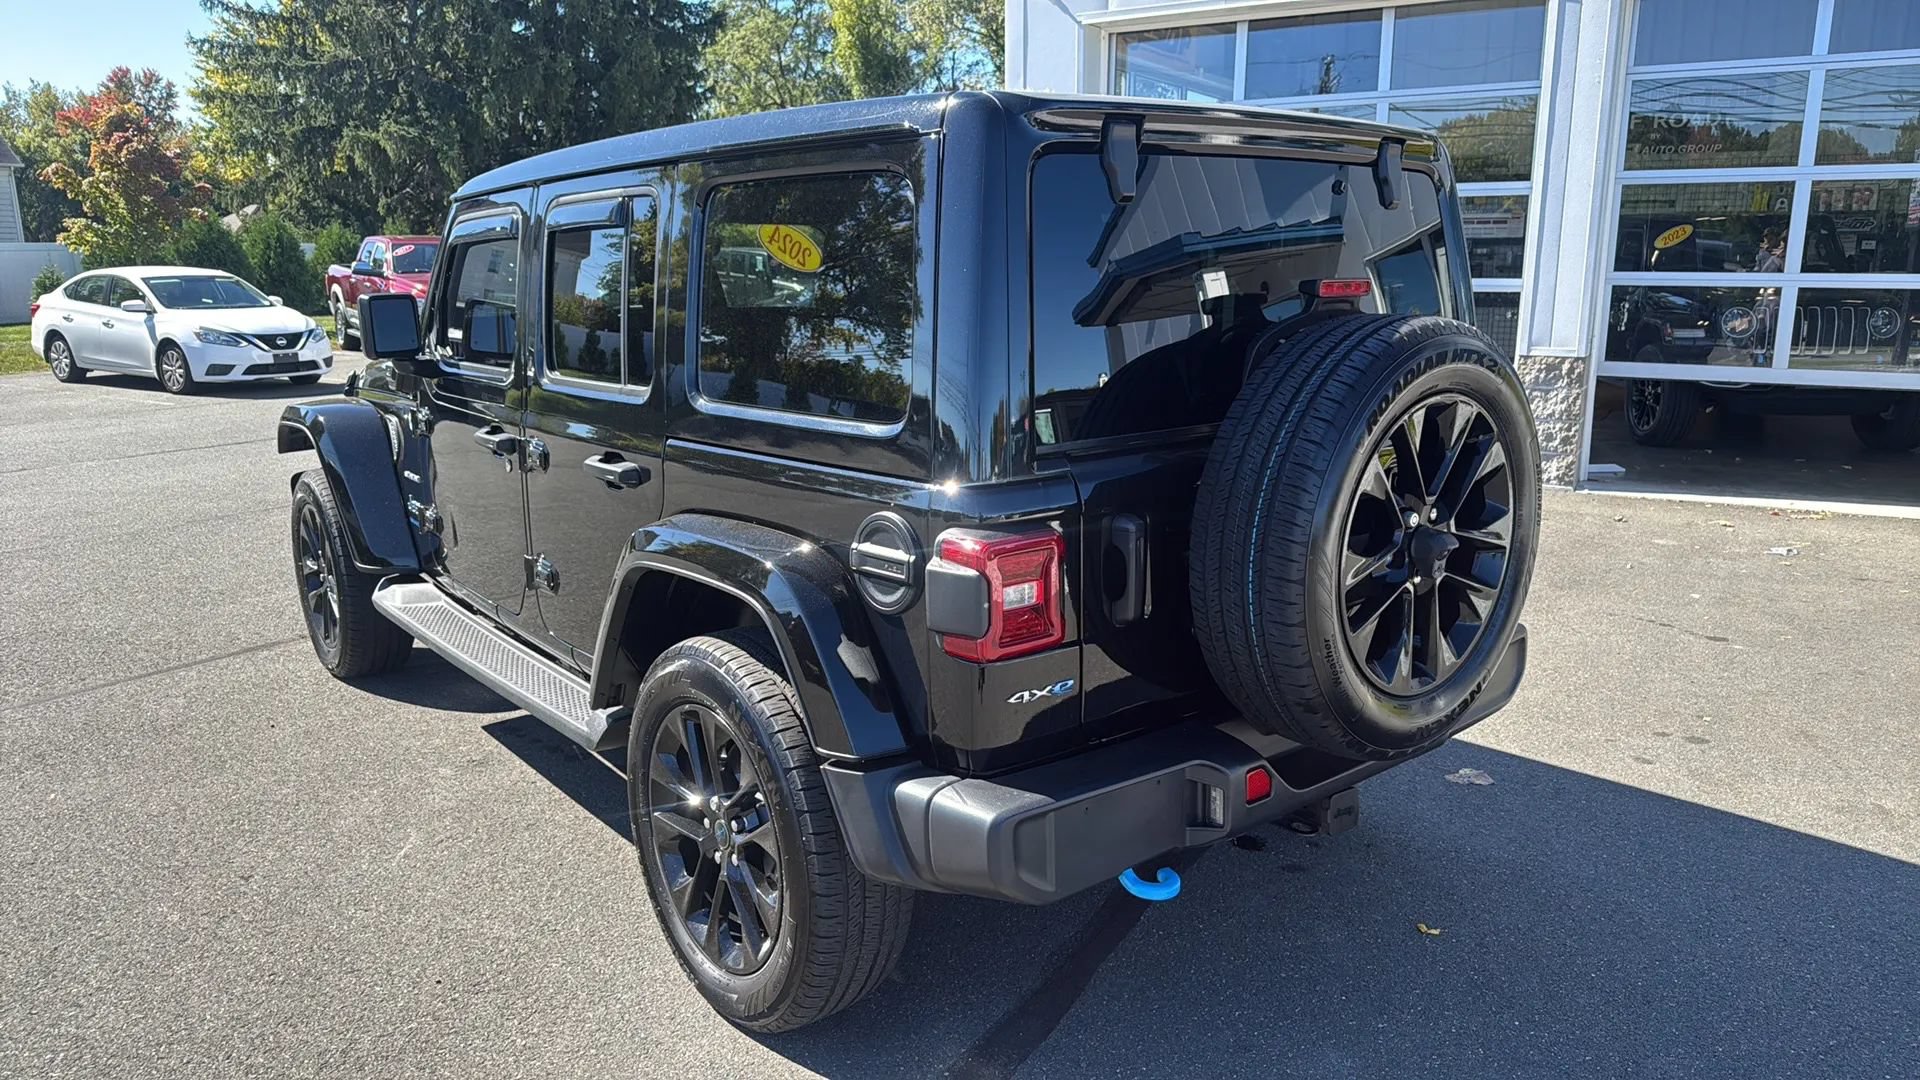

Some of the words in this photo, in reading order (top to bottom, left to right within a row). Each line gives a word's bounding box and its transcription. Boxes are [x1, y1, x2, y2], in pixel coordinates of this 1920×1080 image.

[1641, 145, 1675, 156] AUTO
[1677, 143, 1723, 154] GROUP
[1660, 227, 1687, 246] 2023
[1366, 350, 1449, 437] ROADIAN
[1323, 637, 1342, 688] Weather
